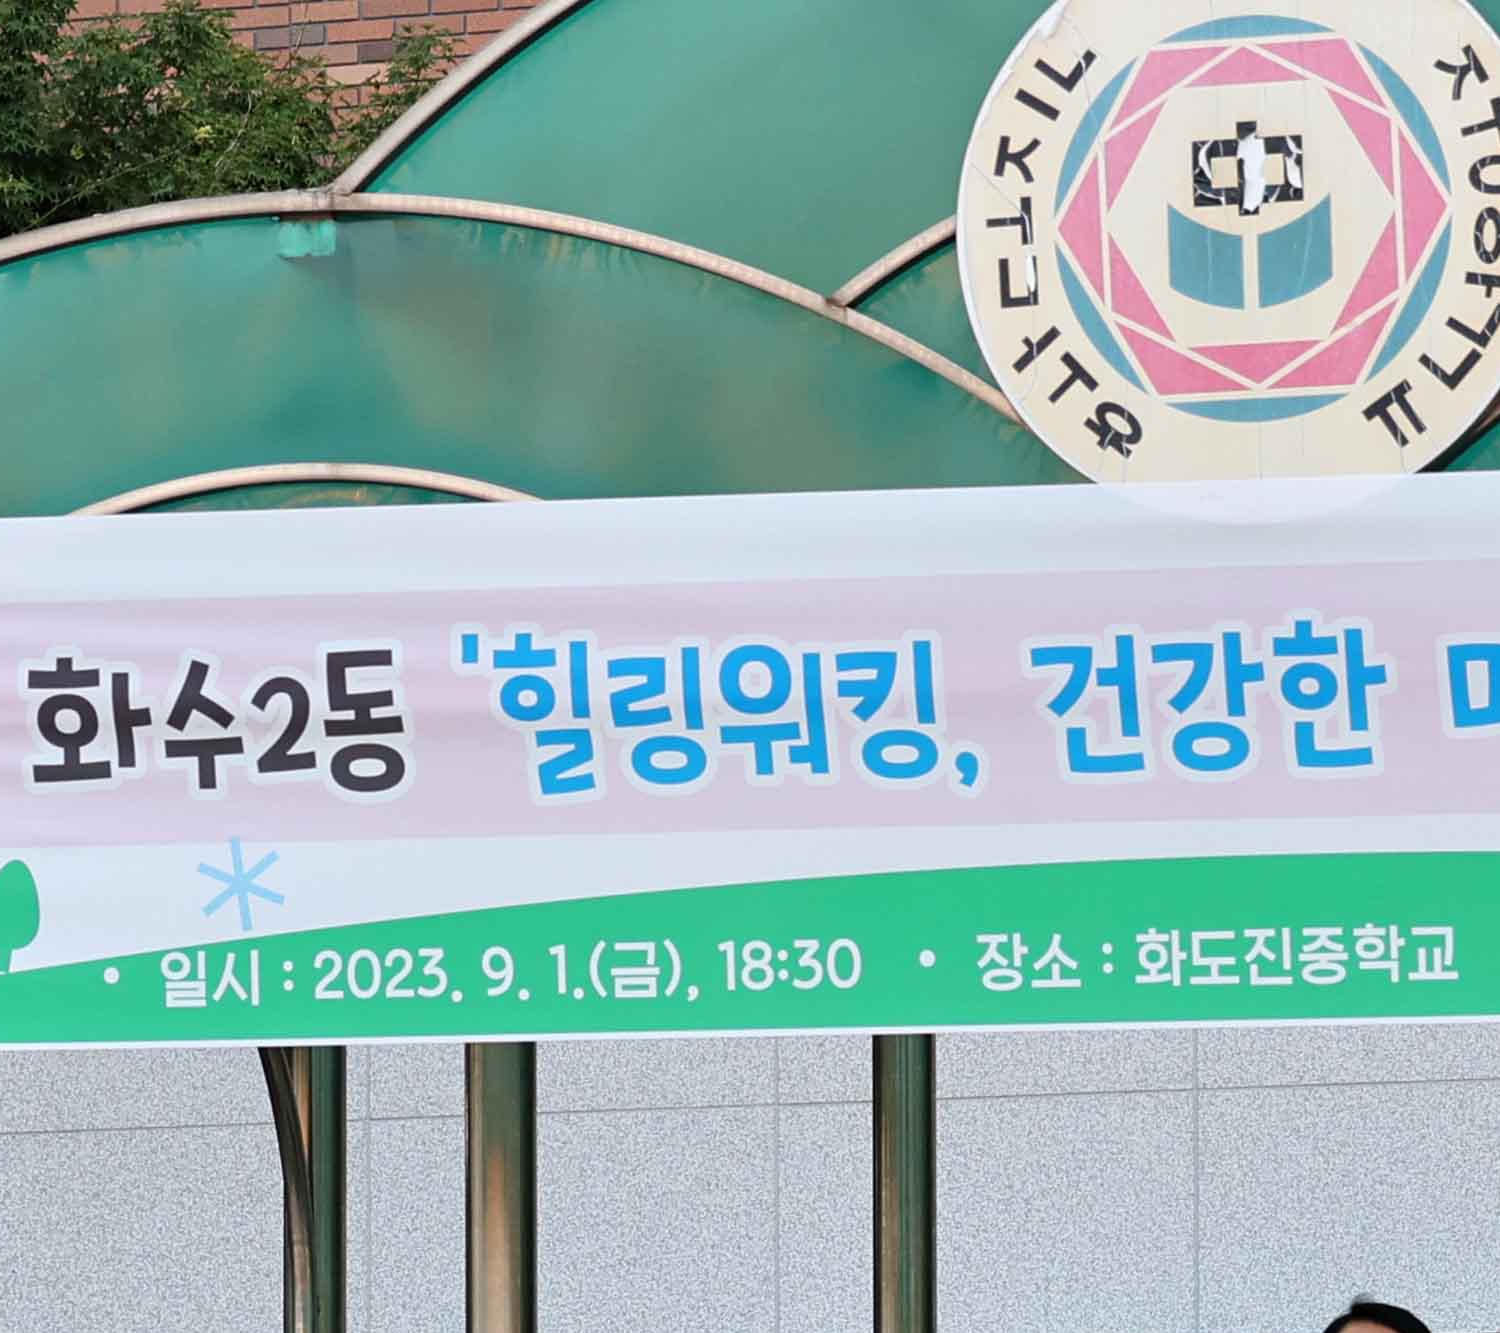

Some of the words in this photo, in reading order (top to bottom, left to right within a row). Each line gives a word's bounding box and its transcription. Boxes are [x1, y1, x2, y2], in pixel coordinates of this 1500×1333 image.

[26, 648, 407, 794] 화수2동
[1030, 618, 1388, 776] 건강한
[159, 947, 263, 1008] 일시
[314, 947, 463, 1003] 2023.
[482, 946, 530, 1001] 9.
[718, 938, 862, 991] 18:30
[976, 933, 1082, 992] 장소
[1135, 923, 1459, 987] 화도진중학교
